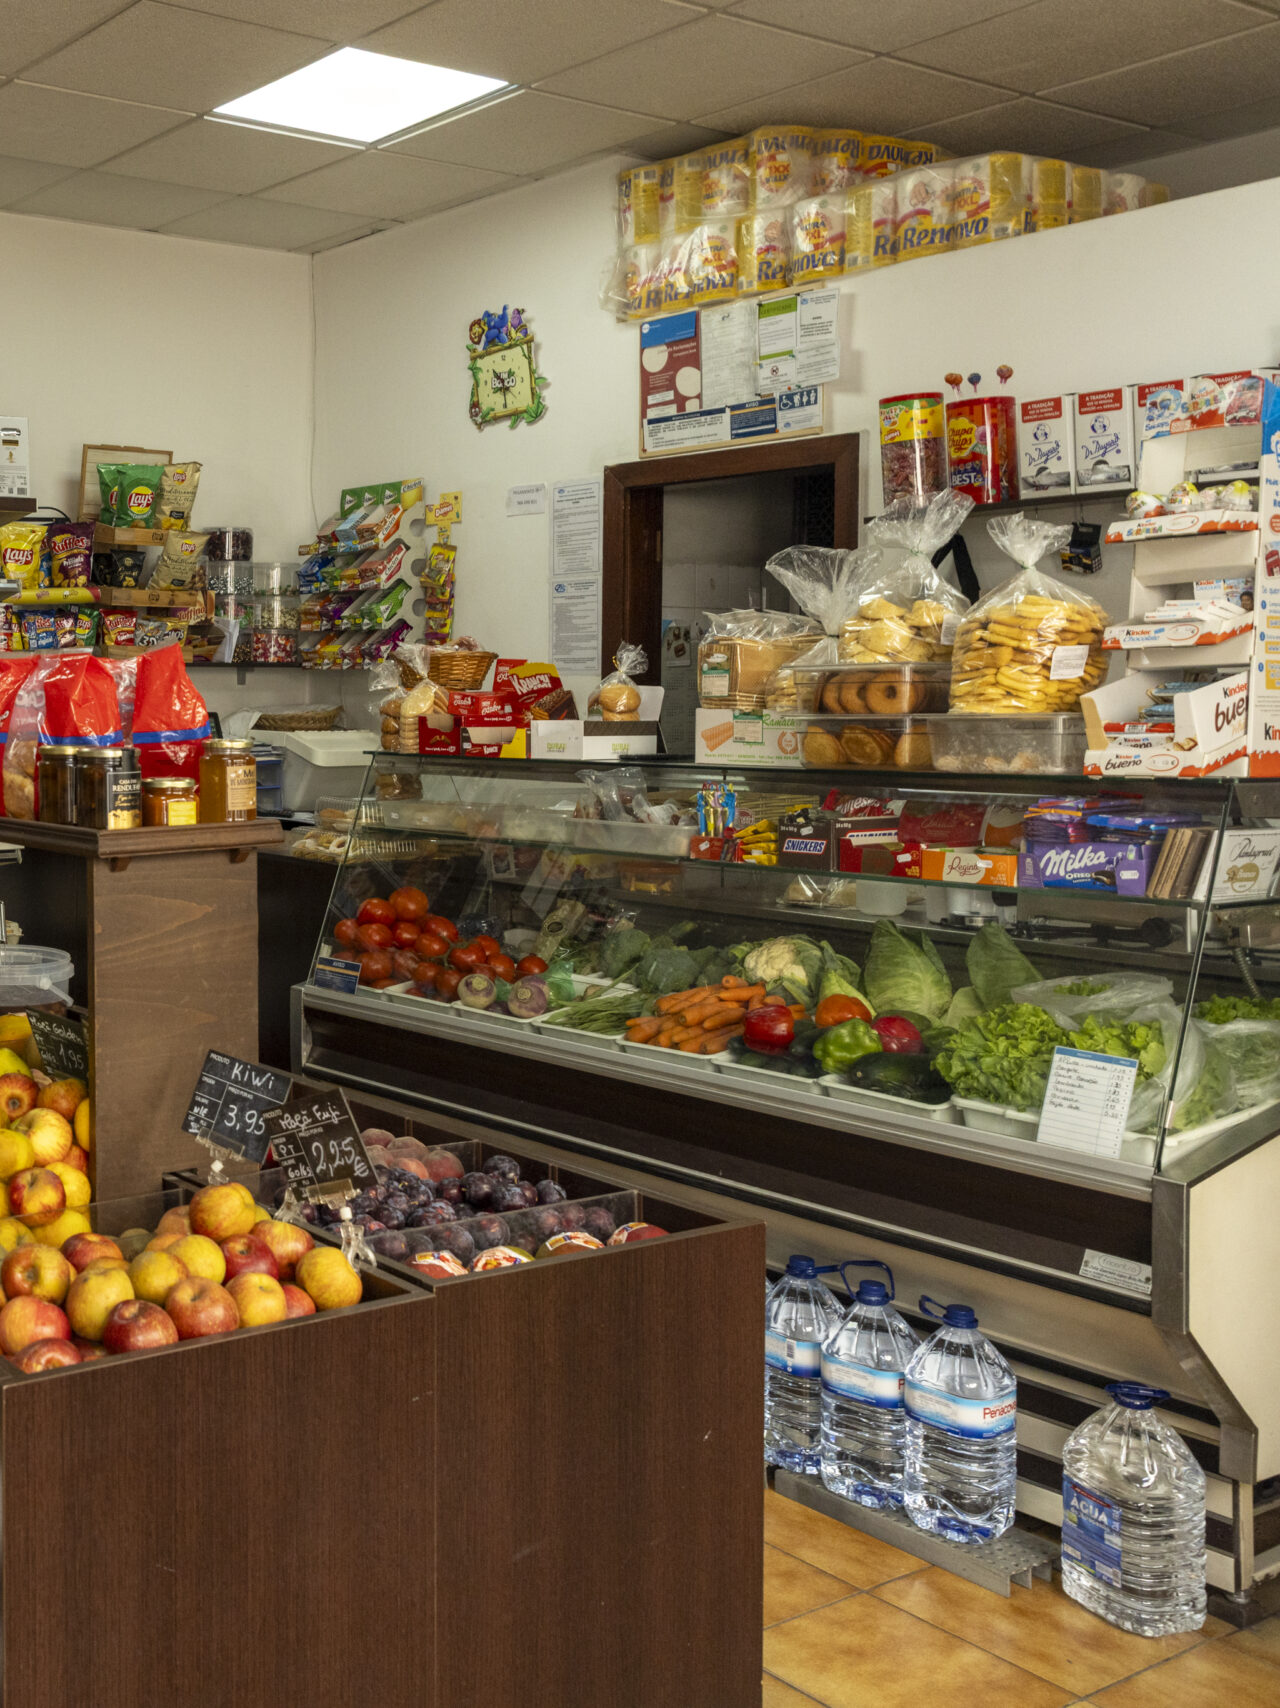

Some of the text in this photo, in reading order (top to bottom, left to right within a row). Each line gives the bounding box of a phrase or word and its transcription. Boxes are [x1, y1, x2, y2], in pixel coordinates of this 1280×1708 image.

[903, 216, 989, 251] Renova
[952, 473, 976, 485] BEST
[130, 493, 154, 508] Lay's
[4, 548, 33, 564] Lay's
[1223, 683, 1247, 699] Kinder
[1214, 698, 1247, 732] bue
[1264, 723, 1280, 740] Kin
[1105, 759, 1142, 770] bueno
[785, 839, 826, 854] SNICKERS
[947, 856, 982, 876] Regina
[1040, 847, 1107, 876] Milka
[210, 1053, 230, 1064] PRODUTO
[224, 1104, 265, 1135] 3,95
[263, 1109, 282, 1118] PRODUTO
[312, 1102, 340, 1124] Fuji
